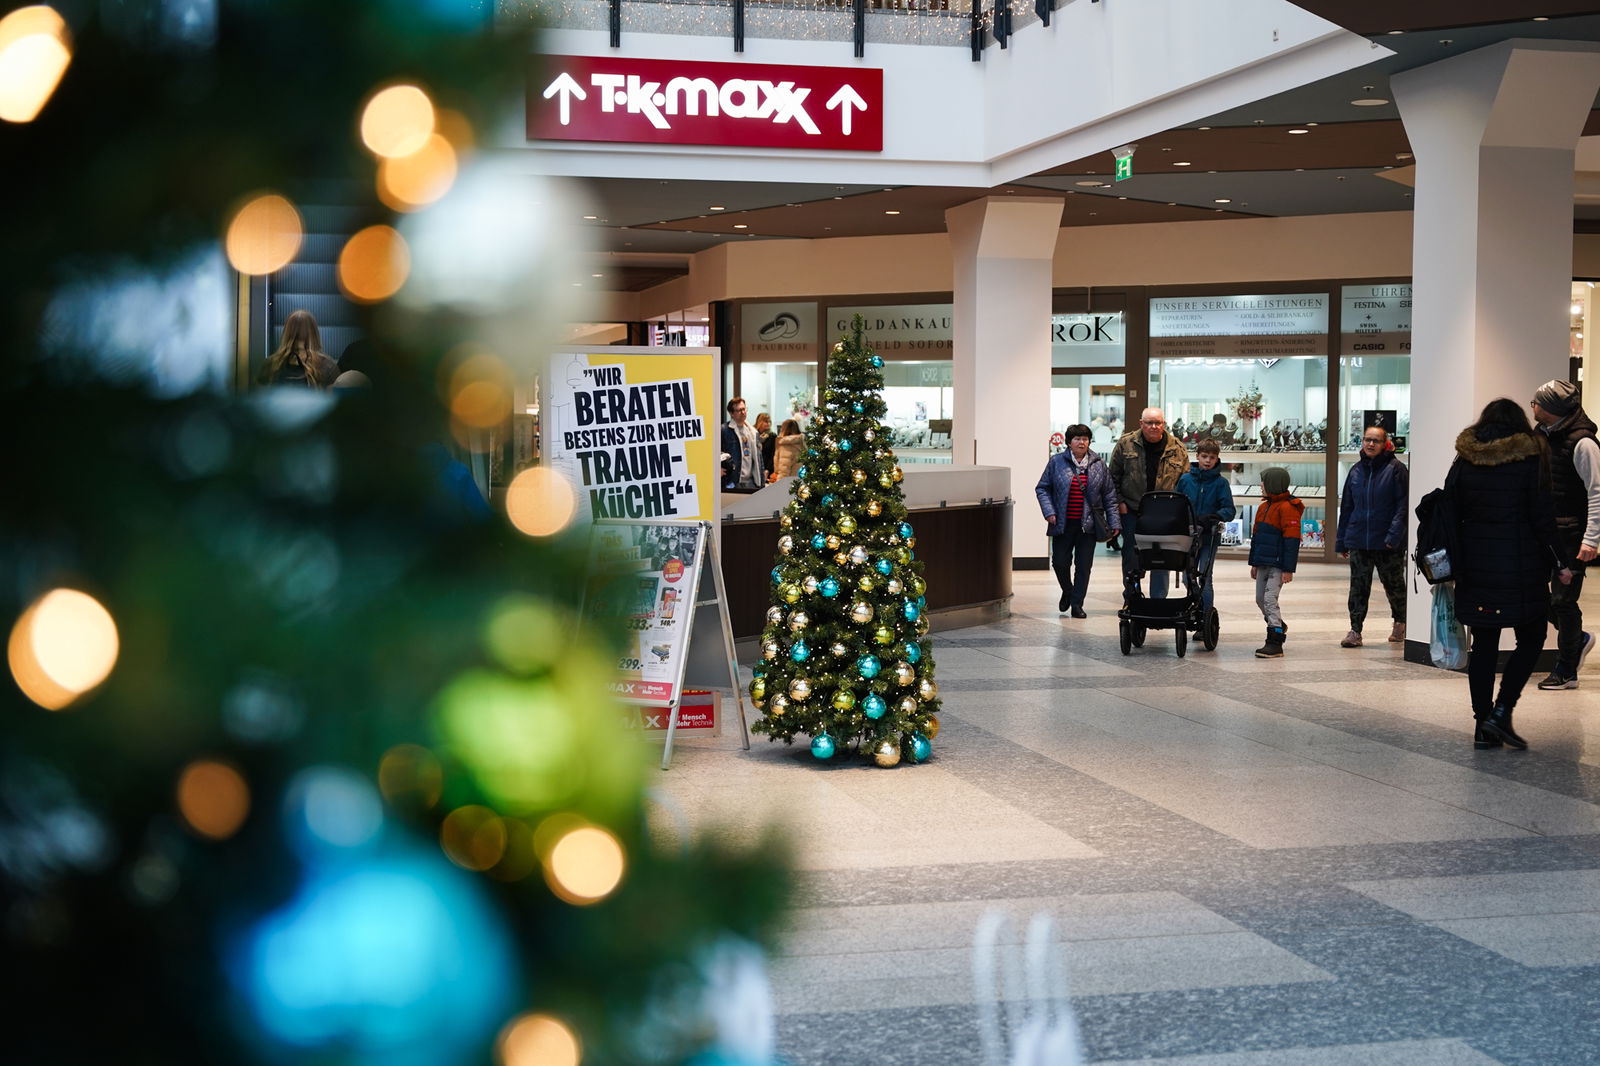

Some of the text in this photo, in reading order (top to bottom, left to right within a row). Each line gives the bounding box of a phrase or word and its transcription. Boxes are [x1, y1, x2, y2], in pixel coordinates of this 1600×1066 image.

[1155, 299, 1322, 311] UNSERE SERVICELEISTUNGEN
[1353, 301, 1386, 309] FESTINA
[1353, 343, 1385, 351] CASIO
[574, 381, 692, 427] BERATEN
[564, 419, 702, 450] BESTENS ZUR NEUEN
[576, 443, 682, 486] TRAUM-
